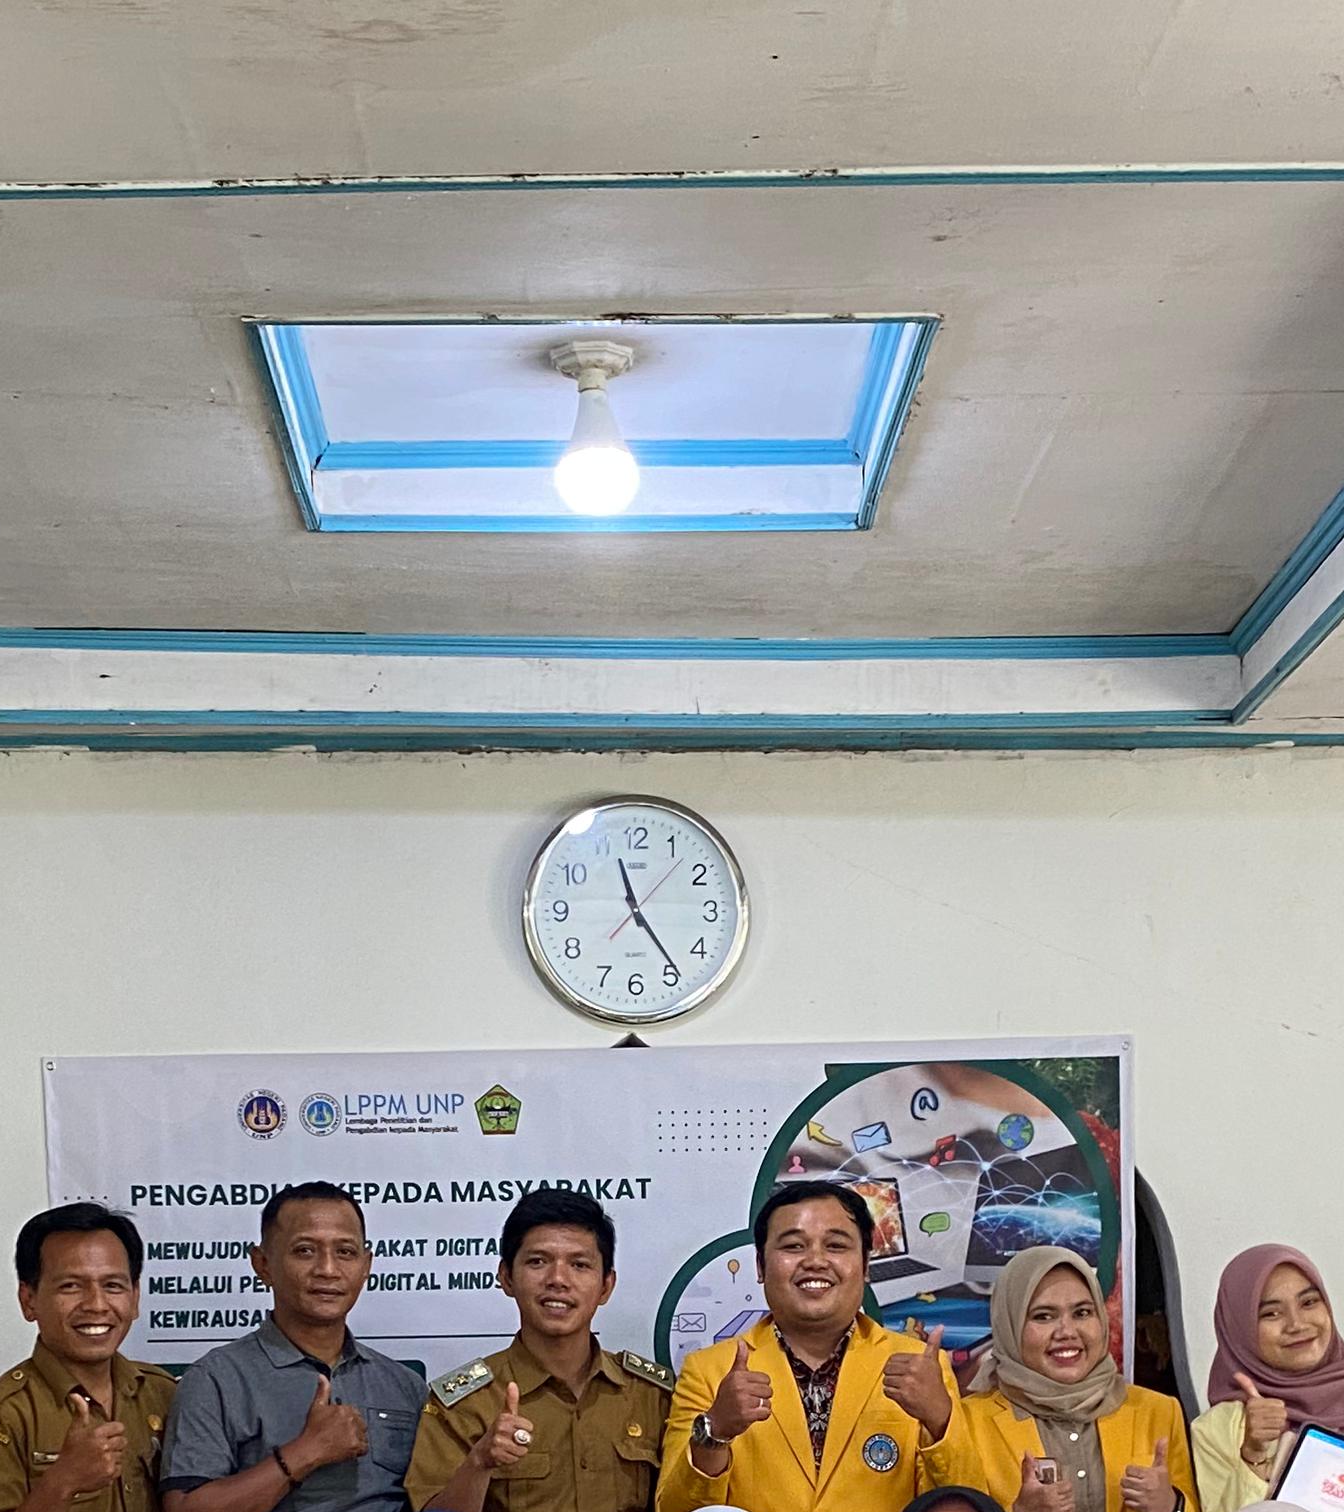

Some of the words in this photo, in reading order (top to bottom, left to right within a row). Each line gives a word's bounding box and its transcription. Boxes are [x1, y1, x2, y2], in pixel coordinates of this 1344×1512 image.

[624, 827, 648, 849] 12
[667, 835, 674, 858] 1
[562, 863, 587, 885] 10
[692, 864, 707, 886] 2
[553, 900, 569, 922] 9
[703, 900, 718, 922] 3
[565, 938, 580, 959] 8
[690, 937, 707, 959] 4
[597, 966, 612, 987] 7
[628, 973, 644, 995] 6
[663, 965, 679, 986] 5
[344, 1094, 407, 1116] LPPM
[416, 1094, 464, 1115] UNP
[345, 1127, 387, 1135] Pengabdian
[130, 1184, 293, 1206] PENGABDI
[339, 1182, 443, 1204] EPADA
[436, 1238, 502, 1257] DIGITA
[149, 1276, 232, 1294] MELALUI
[367, 1272, 441, 1291] DIGITAL
